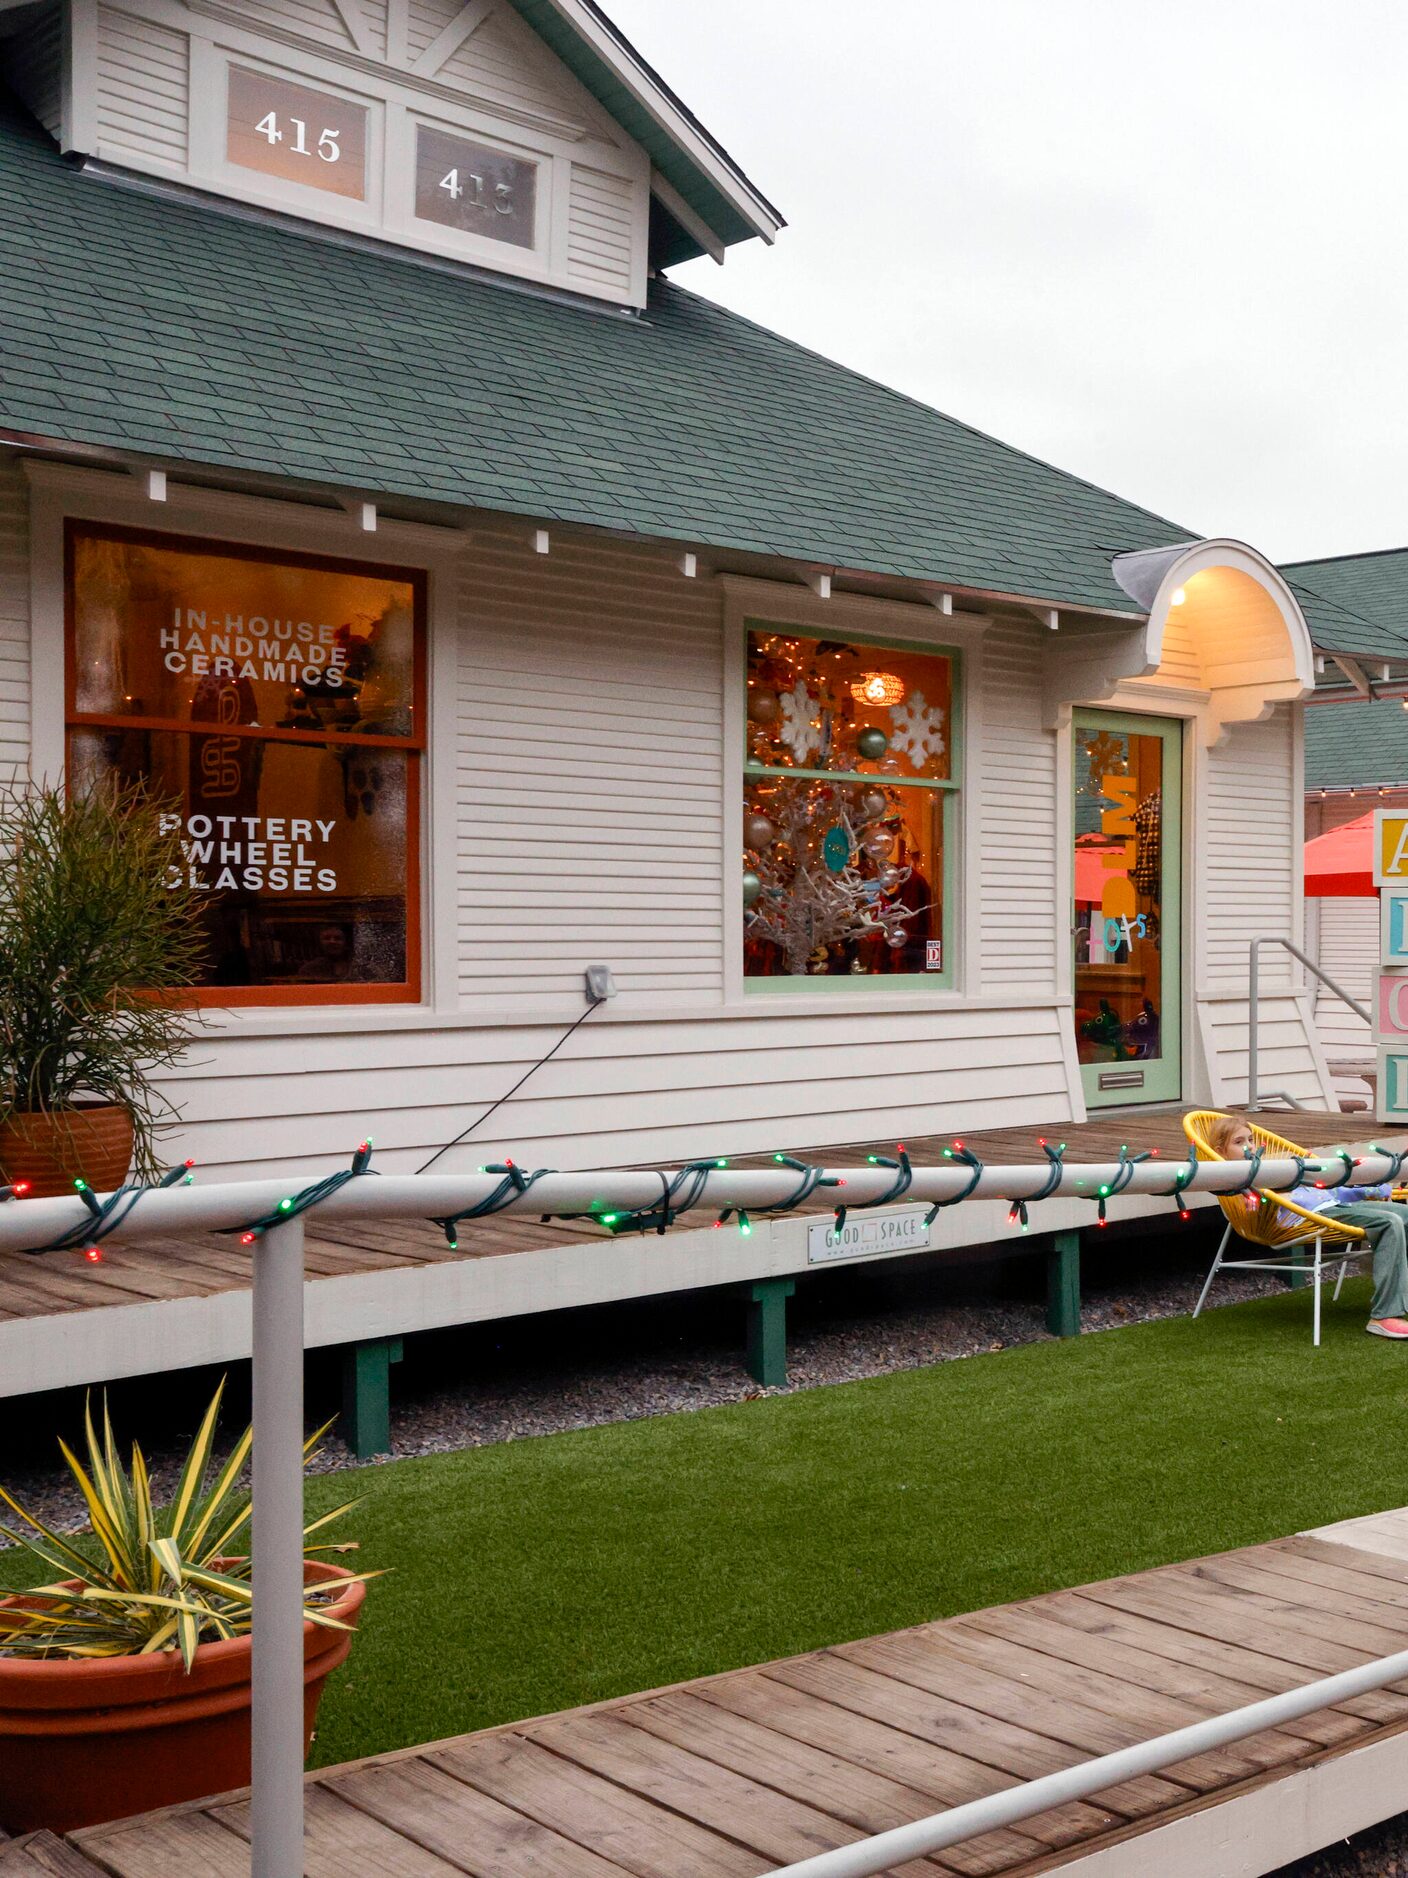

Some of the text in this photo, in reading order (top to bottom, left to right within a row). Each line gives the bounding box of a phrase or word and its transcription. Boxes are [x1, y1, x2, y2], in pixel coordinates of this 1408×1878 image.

[254, 111, 341, 163] 415
[439, 168, 514, 215] 413
[174, 607, 335, 645] IN-HOUSE
[160, 628, 347, 667] HANDMADE
[164, 651, 344, 688] CERAMICS
[159, 813, 337, 842] POTTERY
[180, 839, 317, 867] WHEEL
[159, 864, 337, 892] CLASSES
[881, 1219, 916, 1240] SPACE
